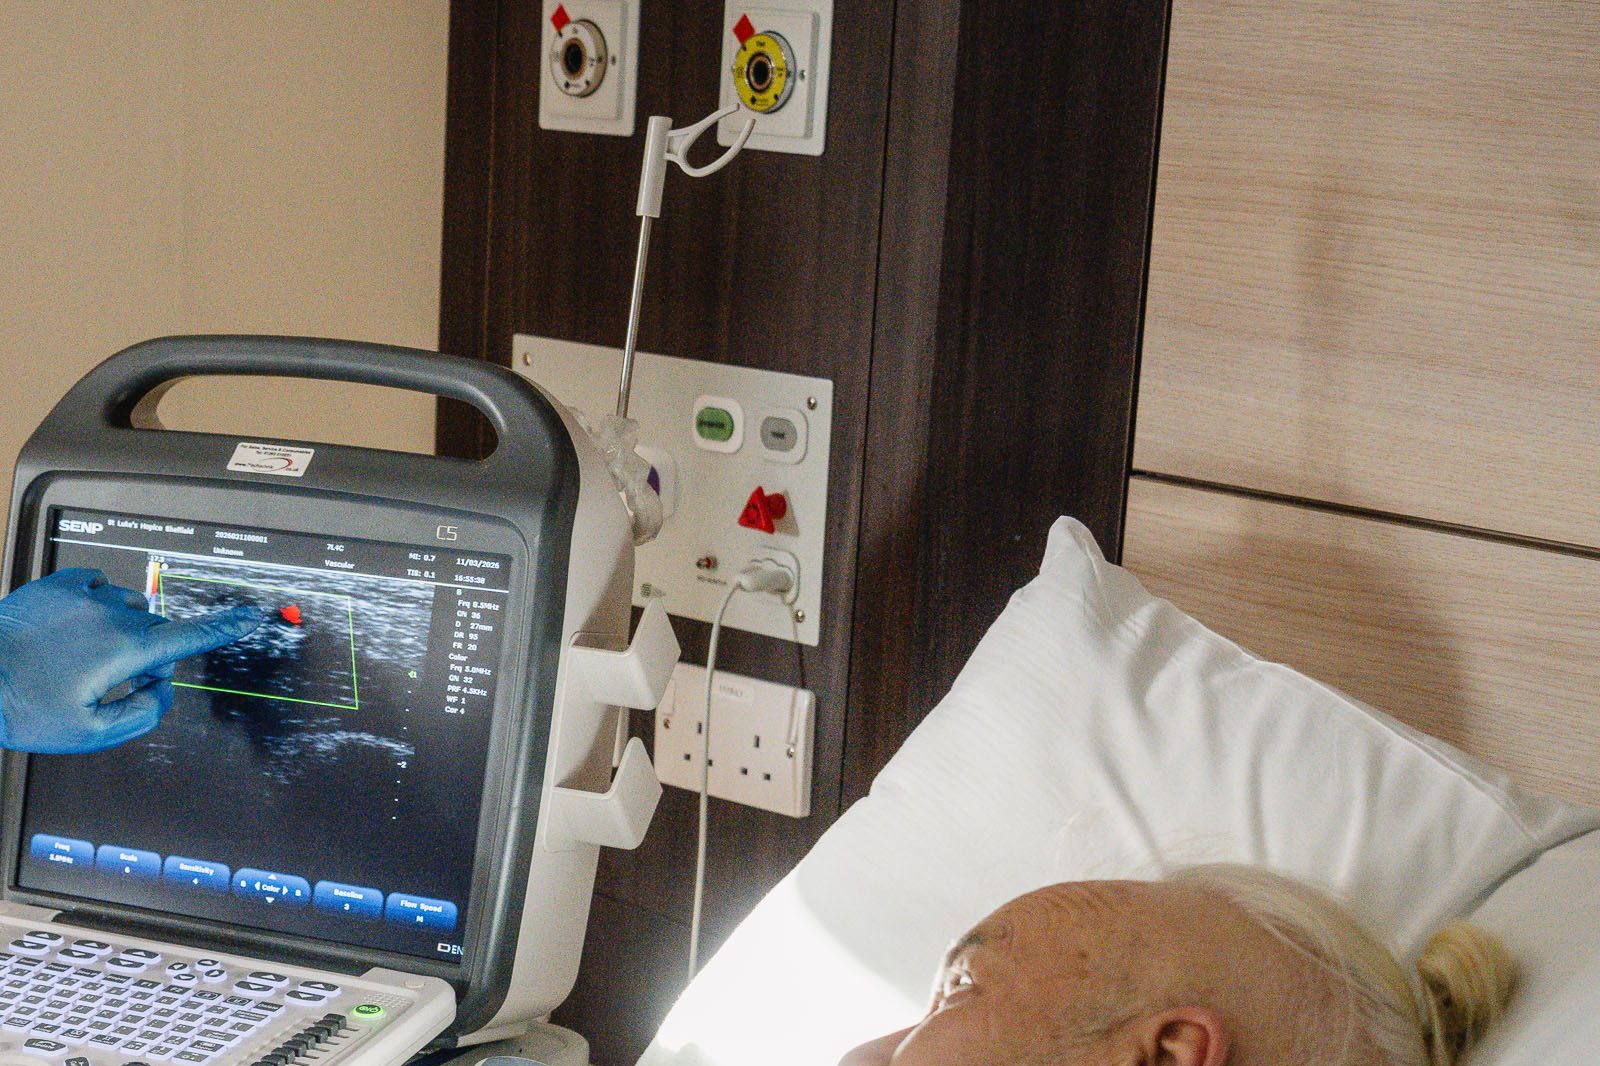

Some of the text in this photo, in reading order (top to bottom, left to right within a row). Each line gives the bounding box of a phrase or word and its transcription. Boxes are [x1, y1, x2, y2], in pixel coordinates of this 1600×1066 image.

[165, 525, 194, 535] Sheffield
[423, 554, 436, 562] 0.7
[324, 559, 355, 569] Vascular
[456, 558, 500, 569] 11/03/2026
[458, 600, 470, 609] Frq
[448, 653, 468, 662] Color
[450, 664, 462, 673] Frq
[463, 676, 473, 684] 32
[262, 884, 281, 894] Color
[334, 888, 364, 900] Baseline
[420, 902, 443, 913] Speed
